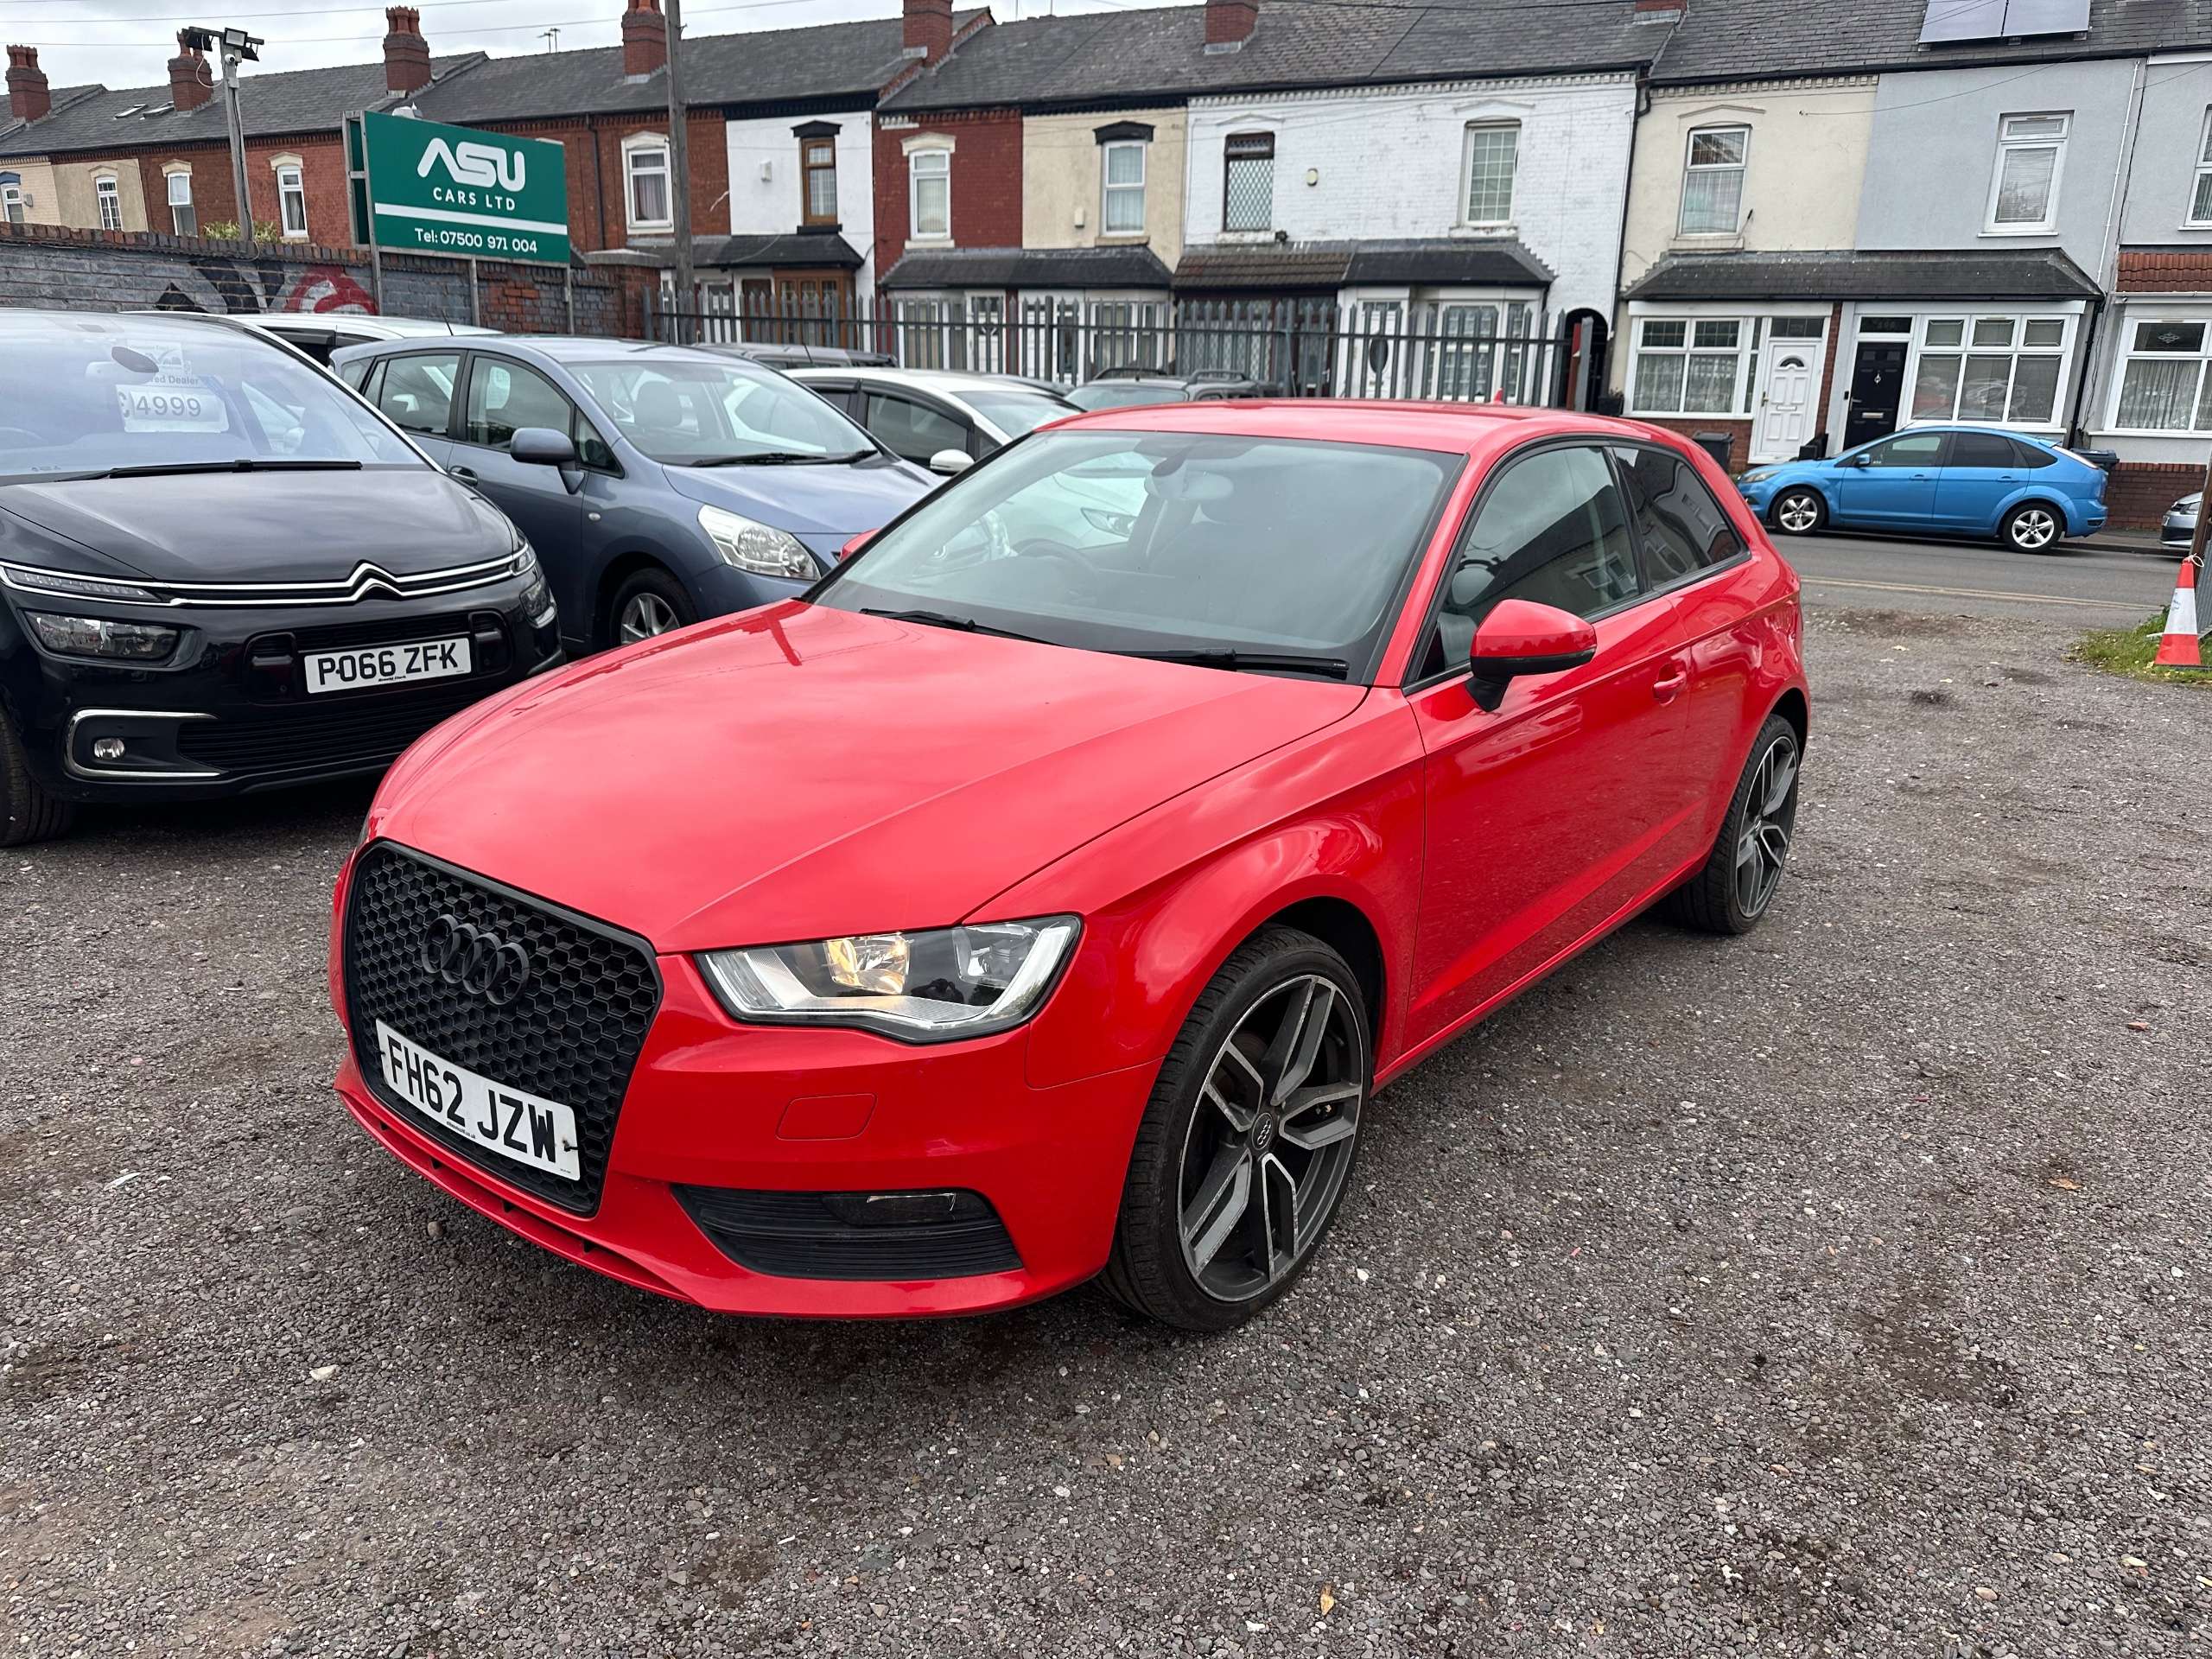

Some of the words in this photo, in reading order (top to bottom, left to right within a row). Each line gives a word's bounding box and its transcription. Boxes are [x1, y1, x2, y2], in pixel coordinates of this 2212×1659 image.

[417, 137, 525, 192] ASU
[433, 187, 476, 206] CARS
[486, 194, 515, 211] LTD
[415, 228, 438, 244] Tel:
[441, 232, 483, 247] 07500
[487, 236, 508, 251] 971
[512, 238, 537, 253] 004
[168, 375, 199, 385] Dealer
[404, 642, 458, 674] ZFK
[387, 1034, 466, 1127] FH62
[477, 1089, 556, 1163] JZW
